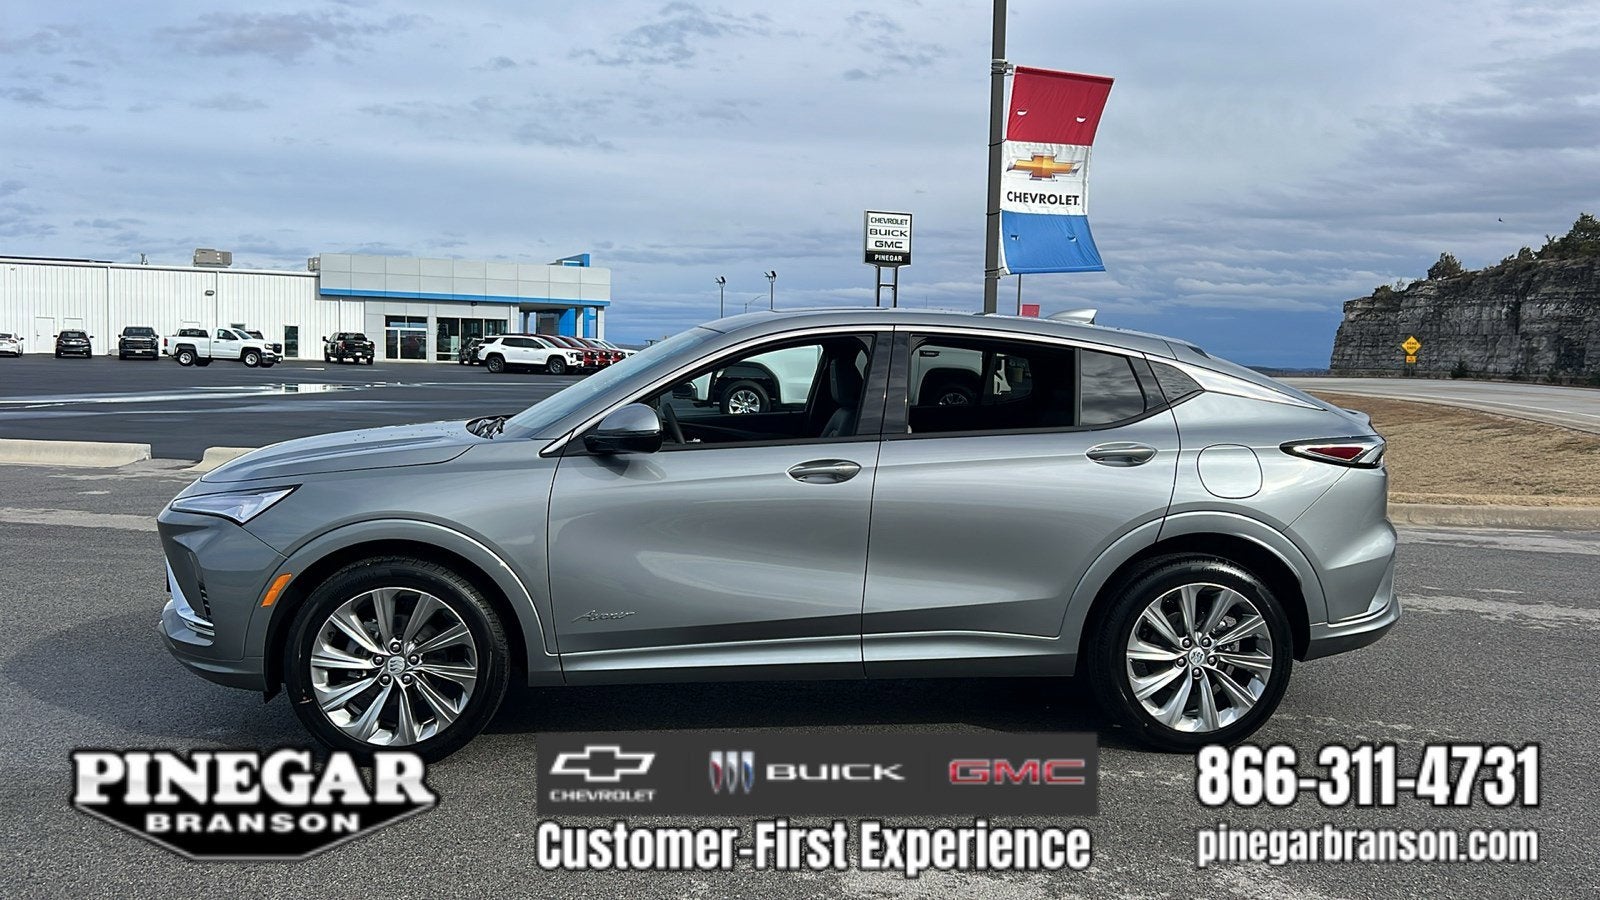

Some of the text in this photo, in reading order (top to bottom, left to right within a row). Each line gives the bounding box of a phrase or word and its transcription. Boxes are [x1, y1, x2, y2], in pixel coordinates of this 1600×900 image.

[870, 217, 908, 225] CHEVROLET
[869, 228, 908, 237] BUICK
[874, 240, 903, 249] GMC
[874, 254, 903, 262] PINEGAR
